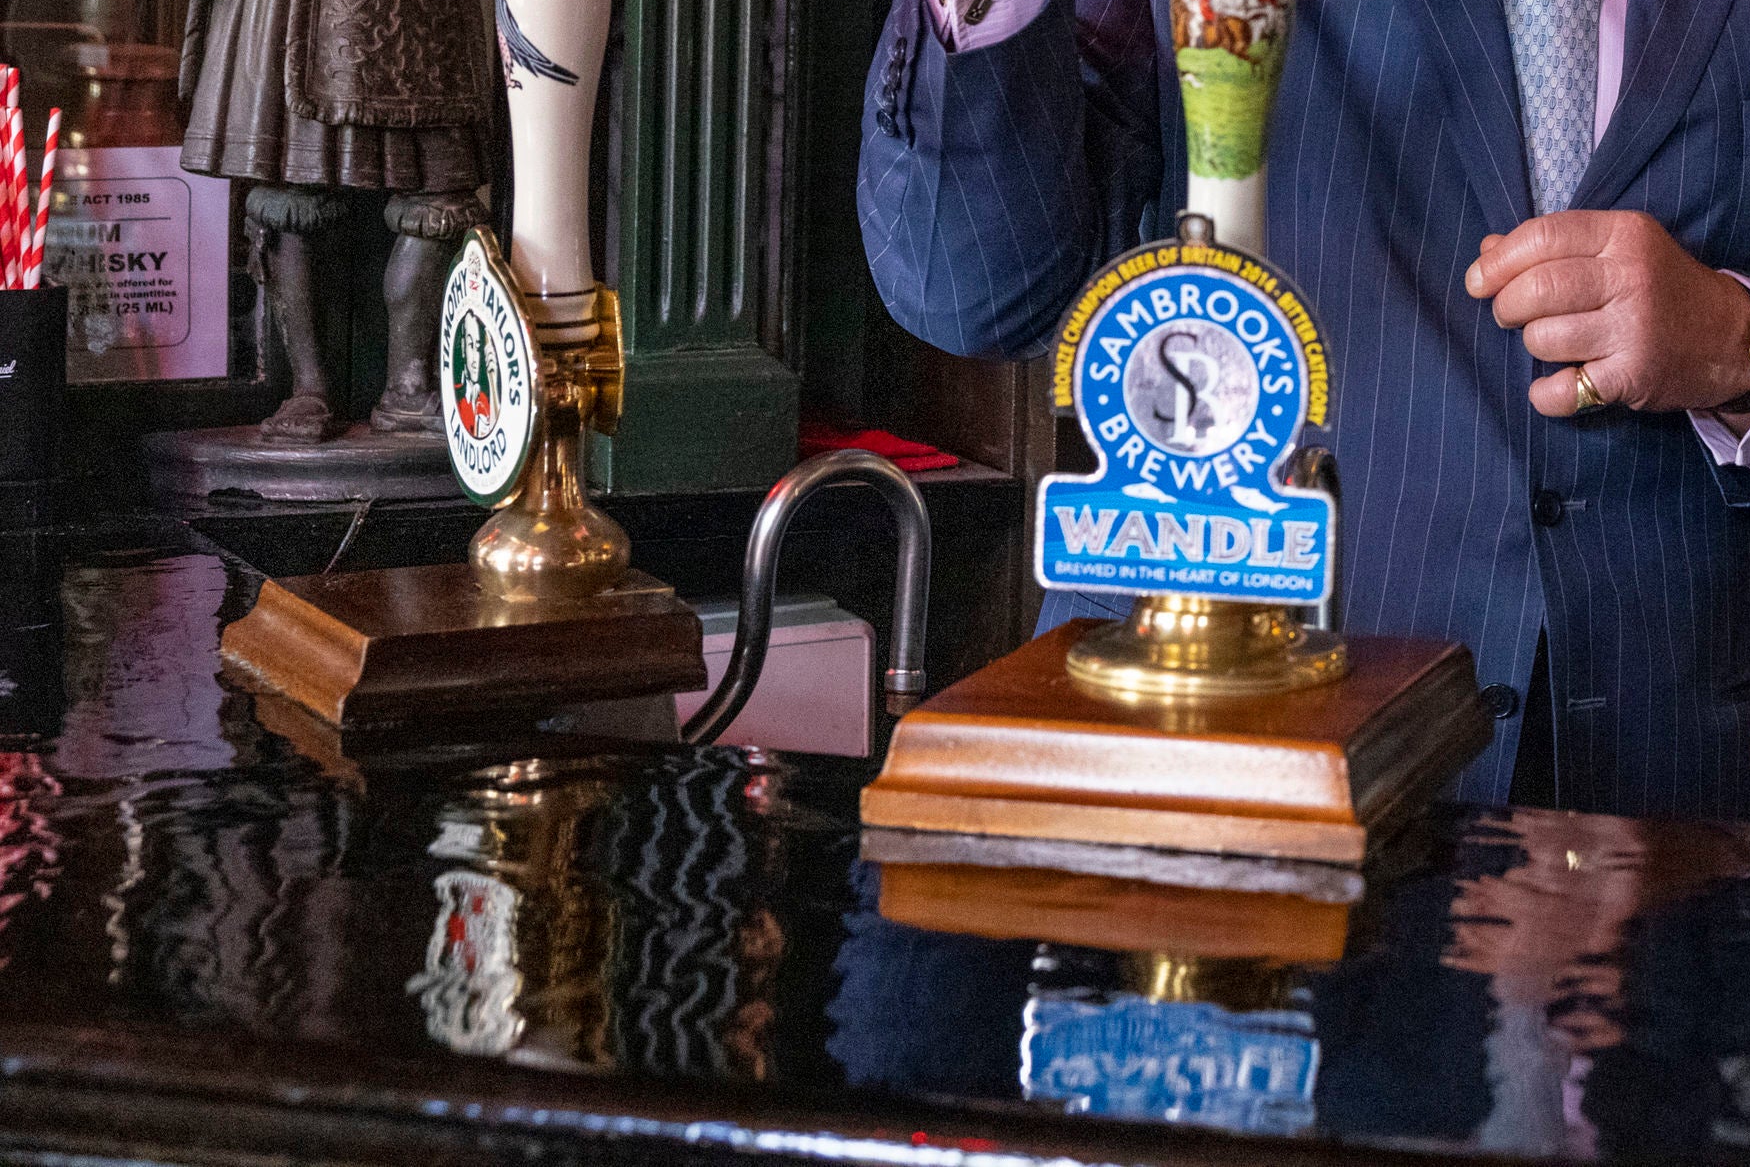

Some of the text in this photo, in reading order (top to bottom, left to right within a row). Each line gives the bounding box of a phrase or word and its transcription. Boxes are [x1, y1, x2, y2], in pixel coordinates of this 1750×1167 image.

[82, 194, 112, 205] ACT
[116, 193, 151, 204] 1985
[1156, 246, 1179, 267] OF
[117, 278, 156, 288] offered
[158, 278, 173, 287] for
[123, 290, 177, 301] quantities
[116, 301, 140, 317] (25
[145, 301, 173, 315] ML)
[443, 267, 521, 407] TIMOTHY TAYLOR'S
[1089, 282, 1295, 395] SAMBROOK'S
[451, 409, 507, 474] LANDLORD
[1097, 412, 1279, 492] BREWERY
[1053, 503, 1322, 571] WANDLE
[1054, 560, 1314, 591] BREWED IN THE HEART OF LONDON
